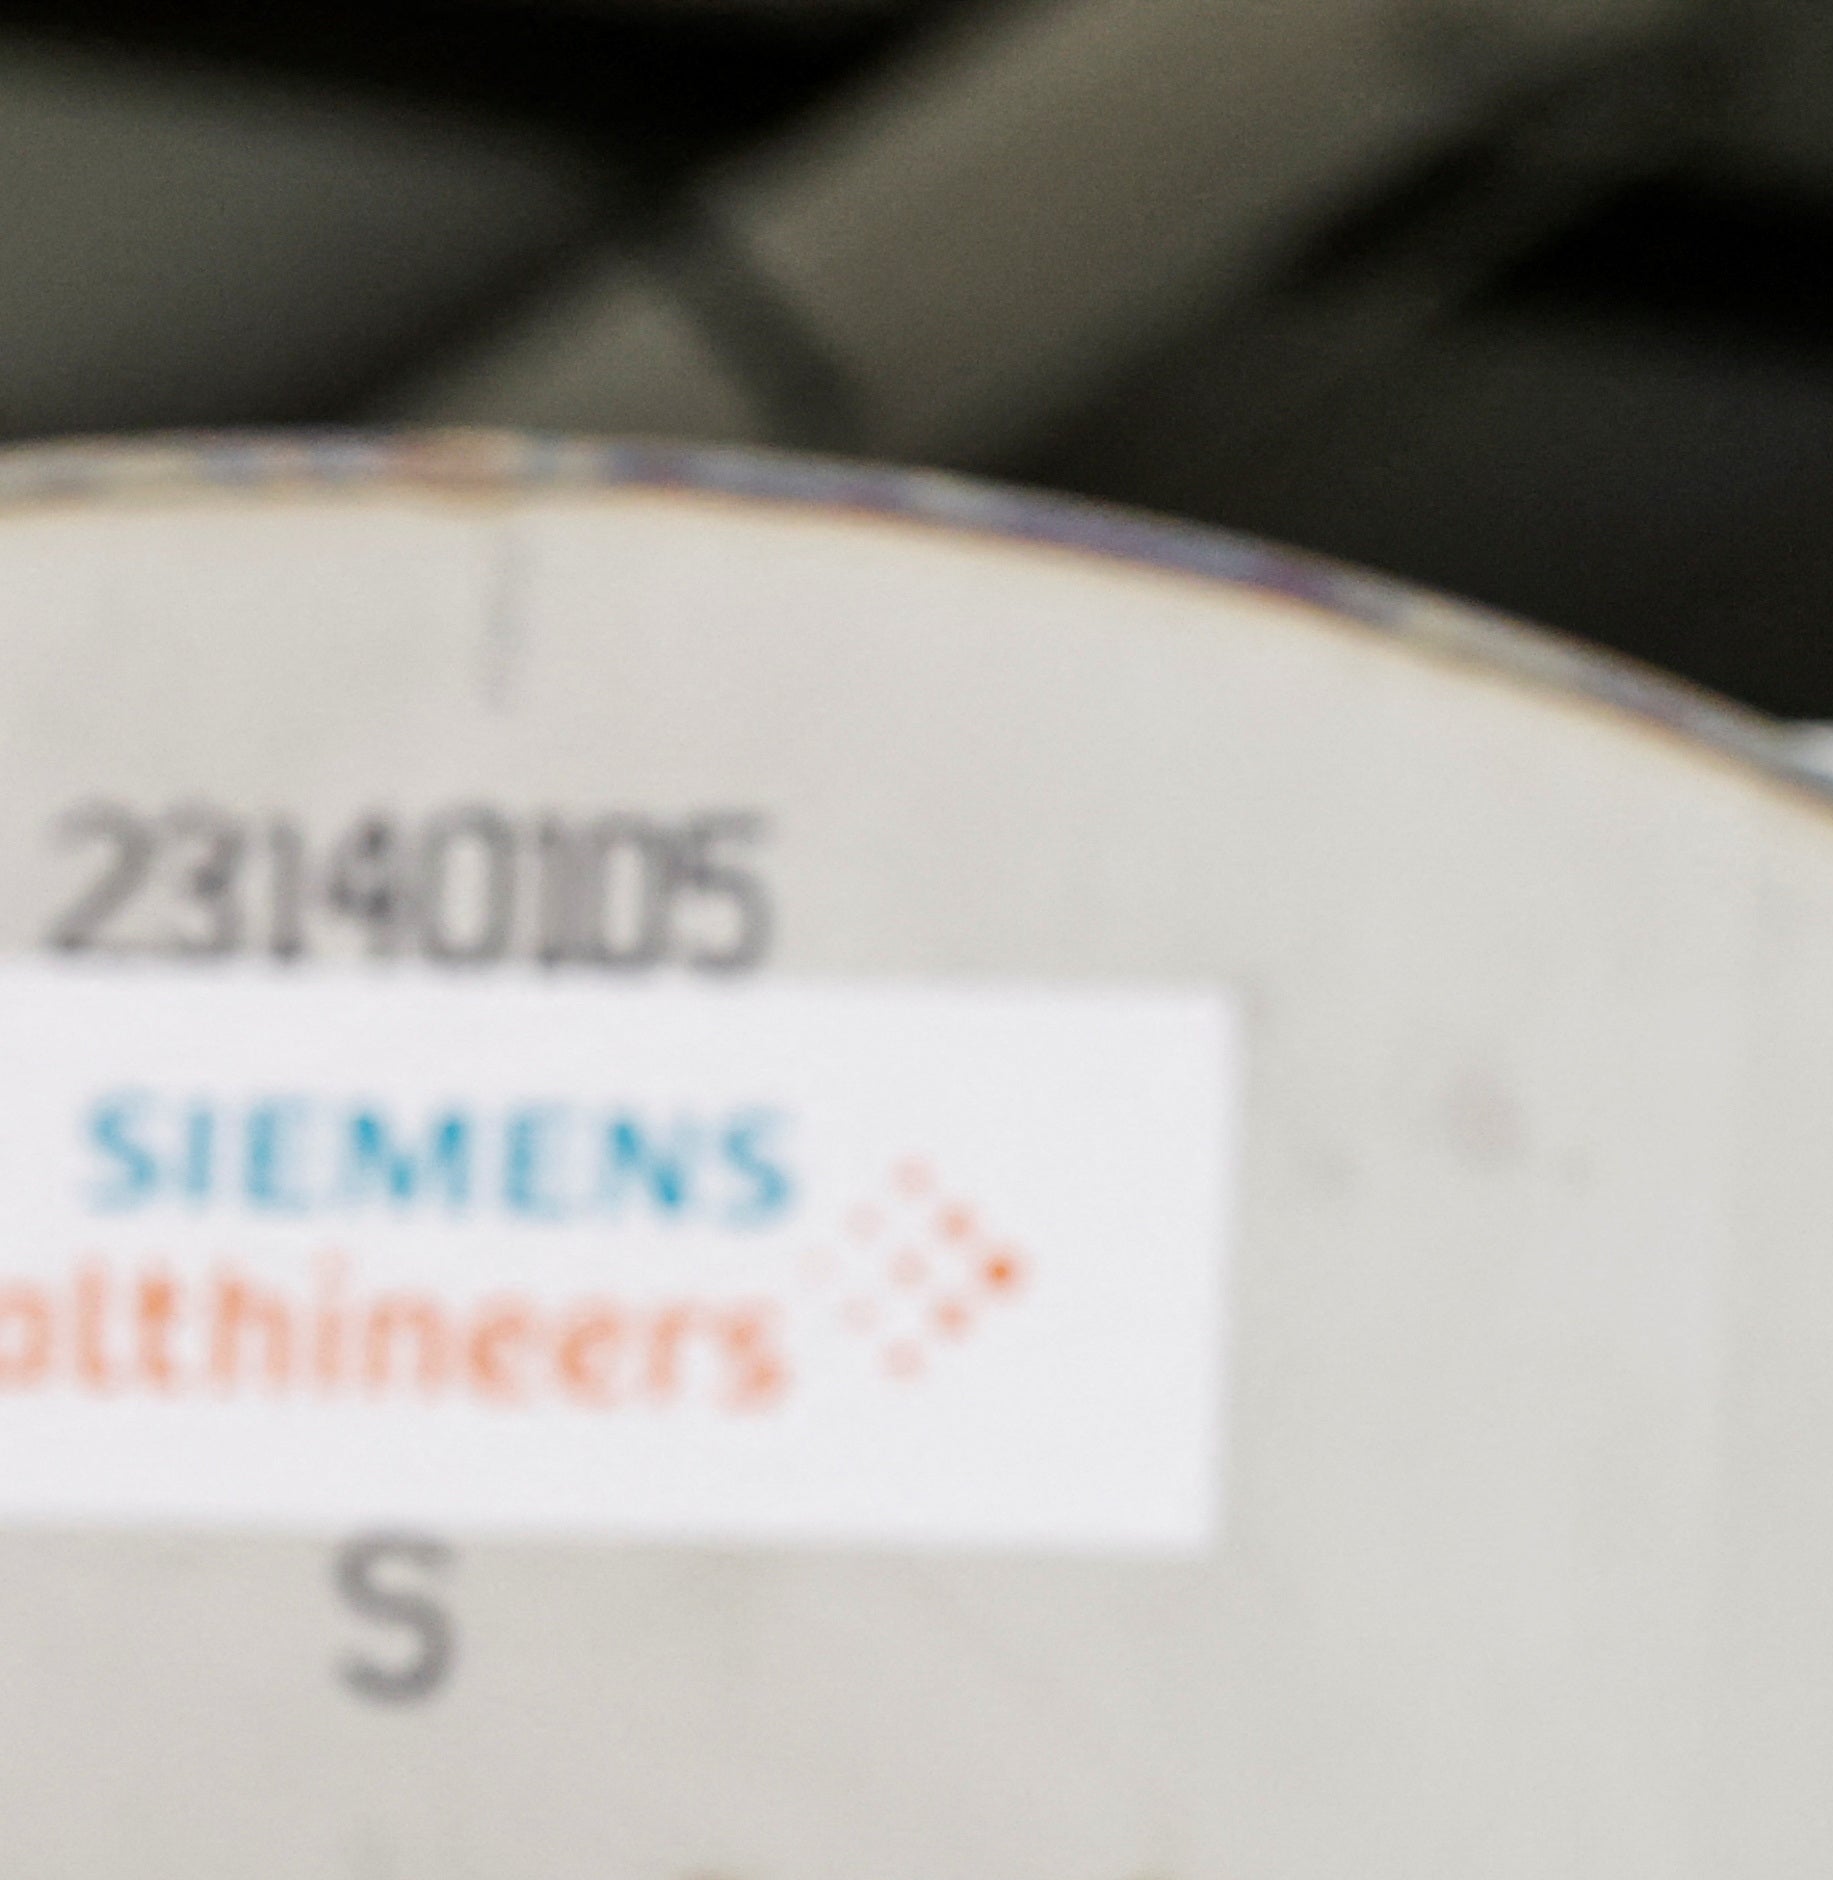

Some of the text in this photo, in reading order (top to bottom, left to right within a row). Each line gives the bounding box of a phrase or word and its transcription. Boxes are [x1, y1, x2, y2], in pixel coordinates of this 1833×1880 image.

[44, 798, 776, 974] 23140105
[84, 1094, 798, 1228] SIEMENS
[333, 1536, 457, 1709] S
